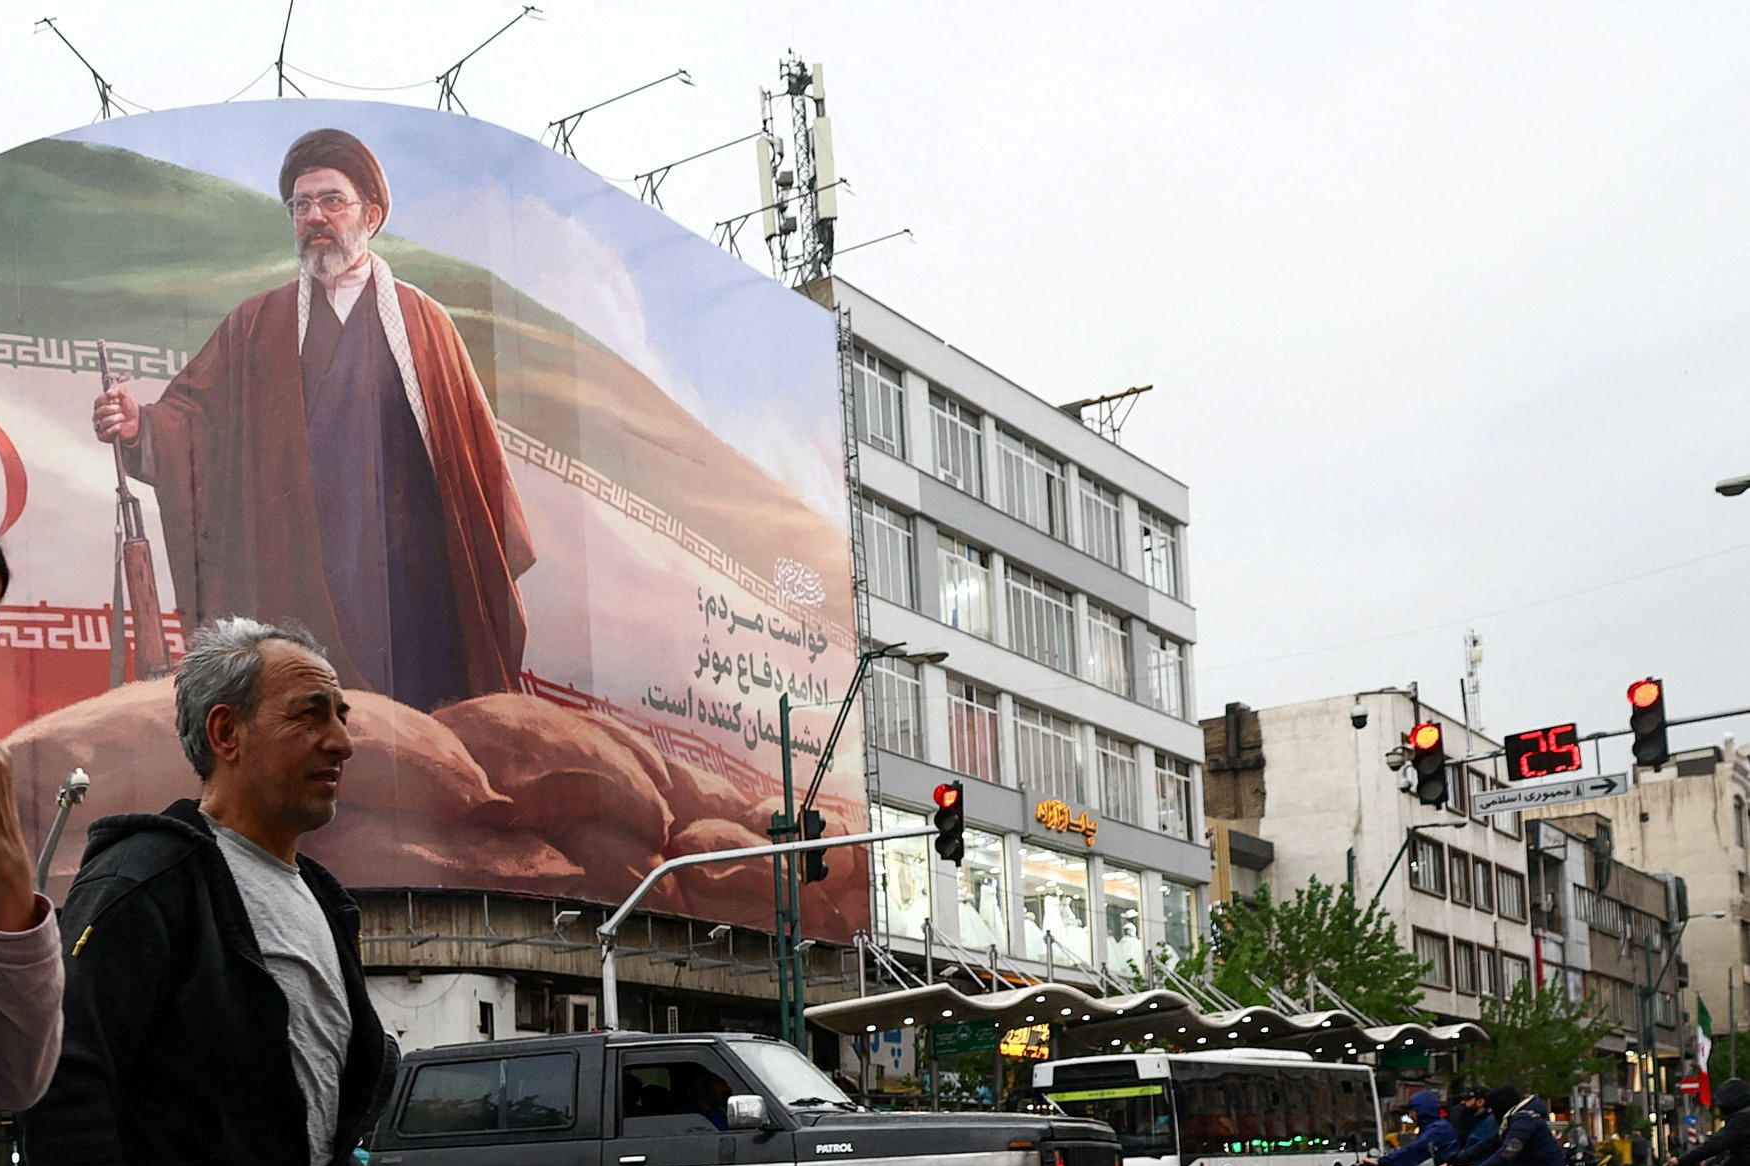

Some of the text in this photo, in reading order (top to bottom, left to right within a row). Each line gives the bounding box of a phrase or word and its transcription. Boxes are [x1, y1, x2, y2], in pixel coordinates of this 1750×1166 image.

[768, 617, 827, 664] خواست
[737, 652, 783, 694] دفاع
[788, 672, 828, 708] ادامه
[1518, 725, 1581, 778] 25
[1479, 789, 1571, 810] جمهوری اسلامی
[816, 1143, 854, 1154] PATROL
